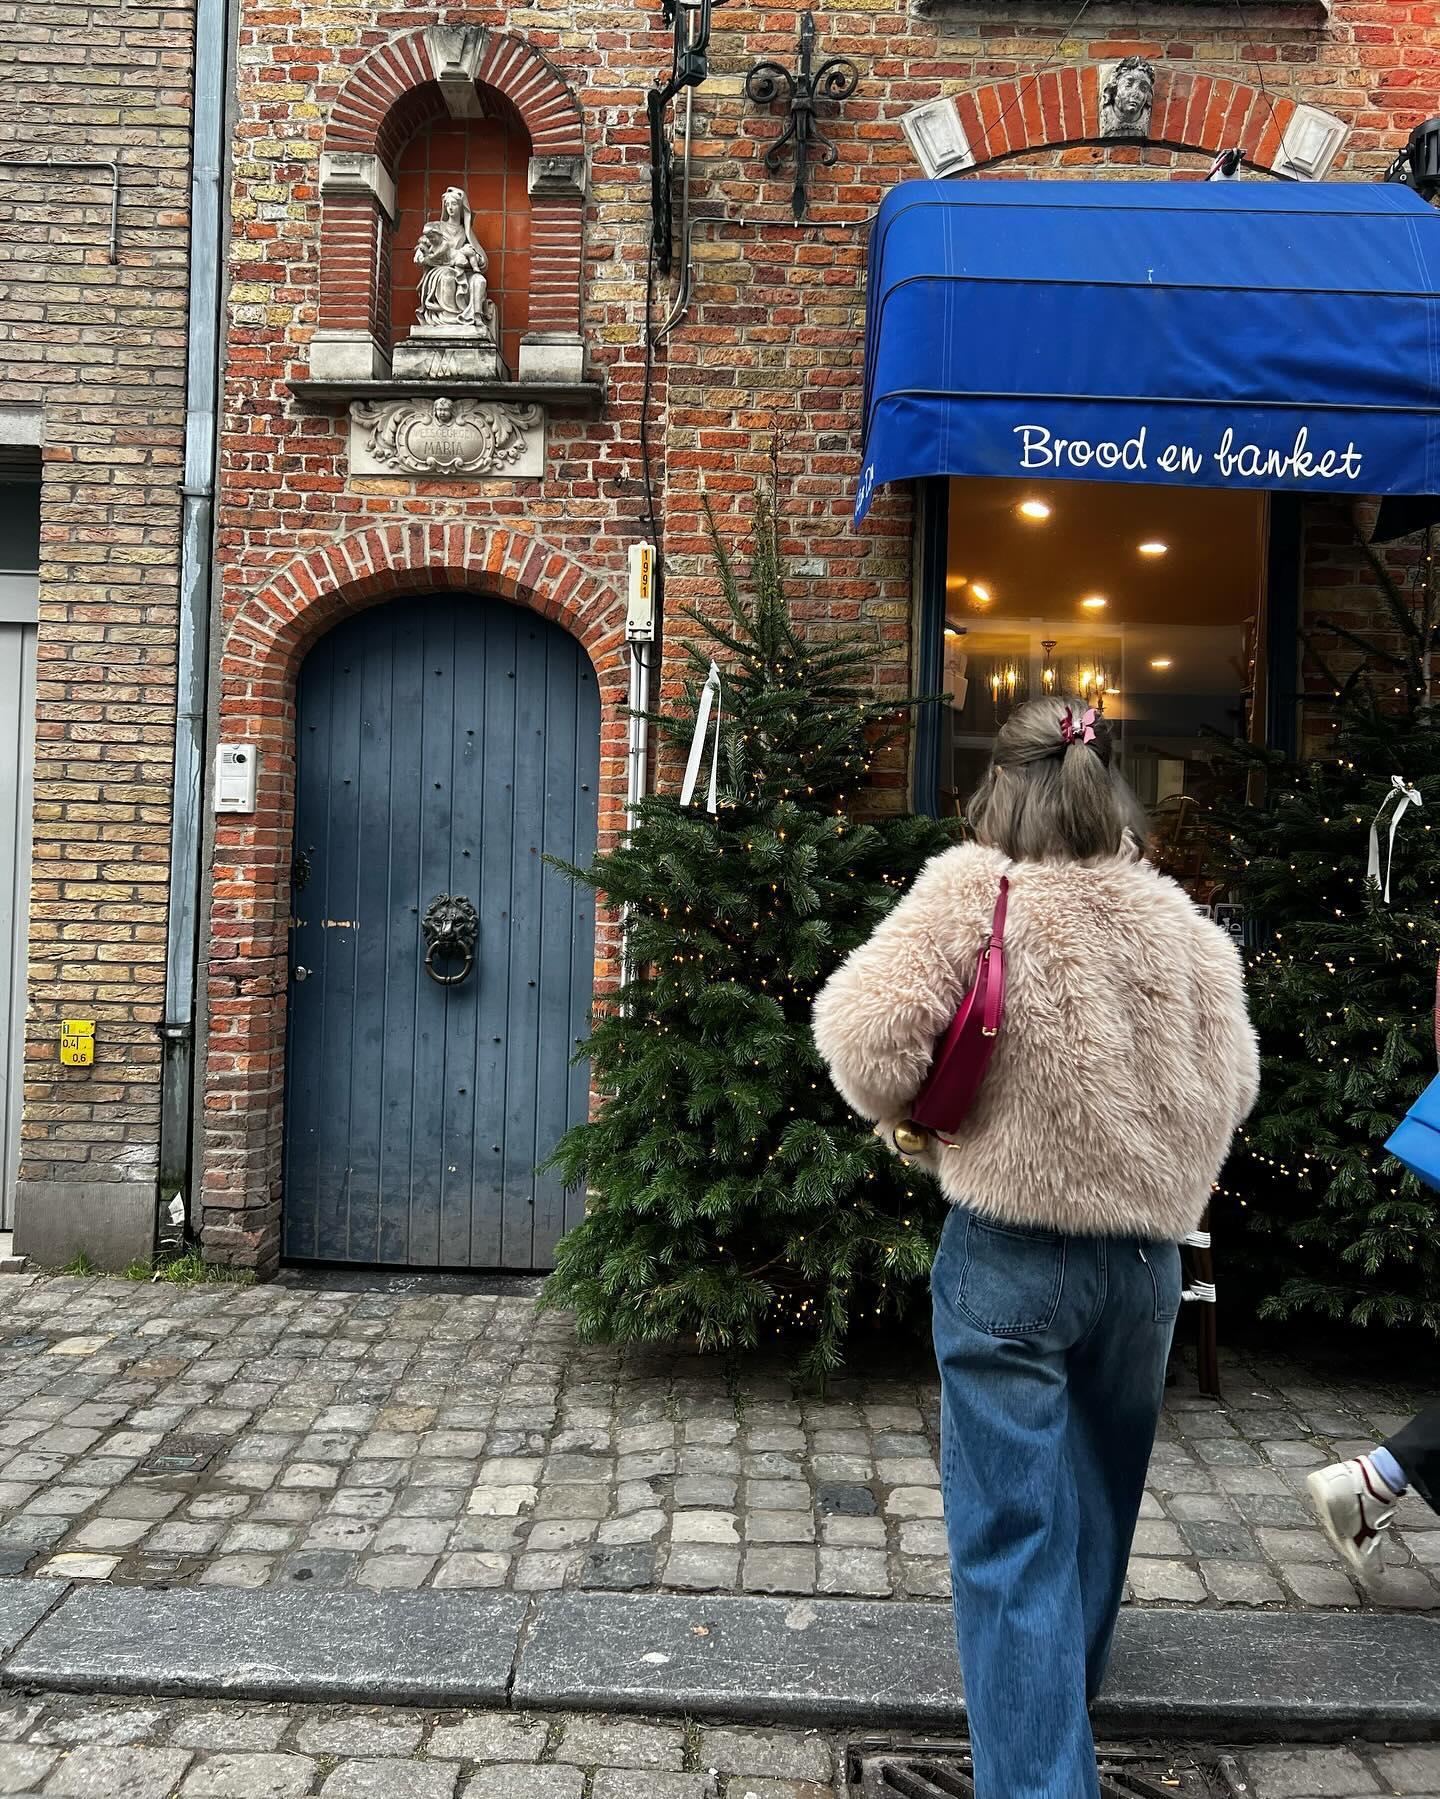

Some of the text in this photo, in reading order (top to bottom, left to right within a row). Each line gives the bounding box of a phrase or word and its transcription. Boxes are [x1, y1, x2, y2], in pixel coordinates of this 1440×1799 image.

[424, 441, 464, 456] MARIA
[1013, 425, 1363, 479] Brood en banket
[72, 1053, 86, 1063] 0,6
